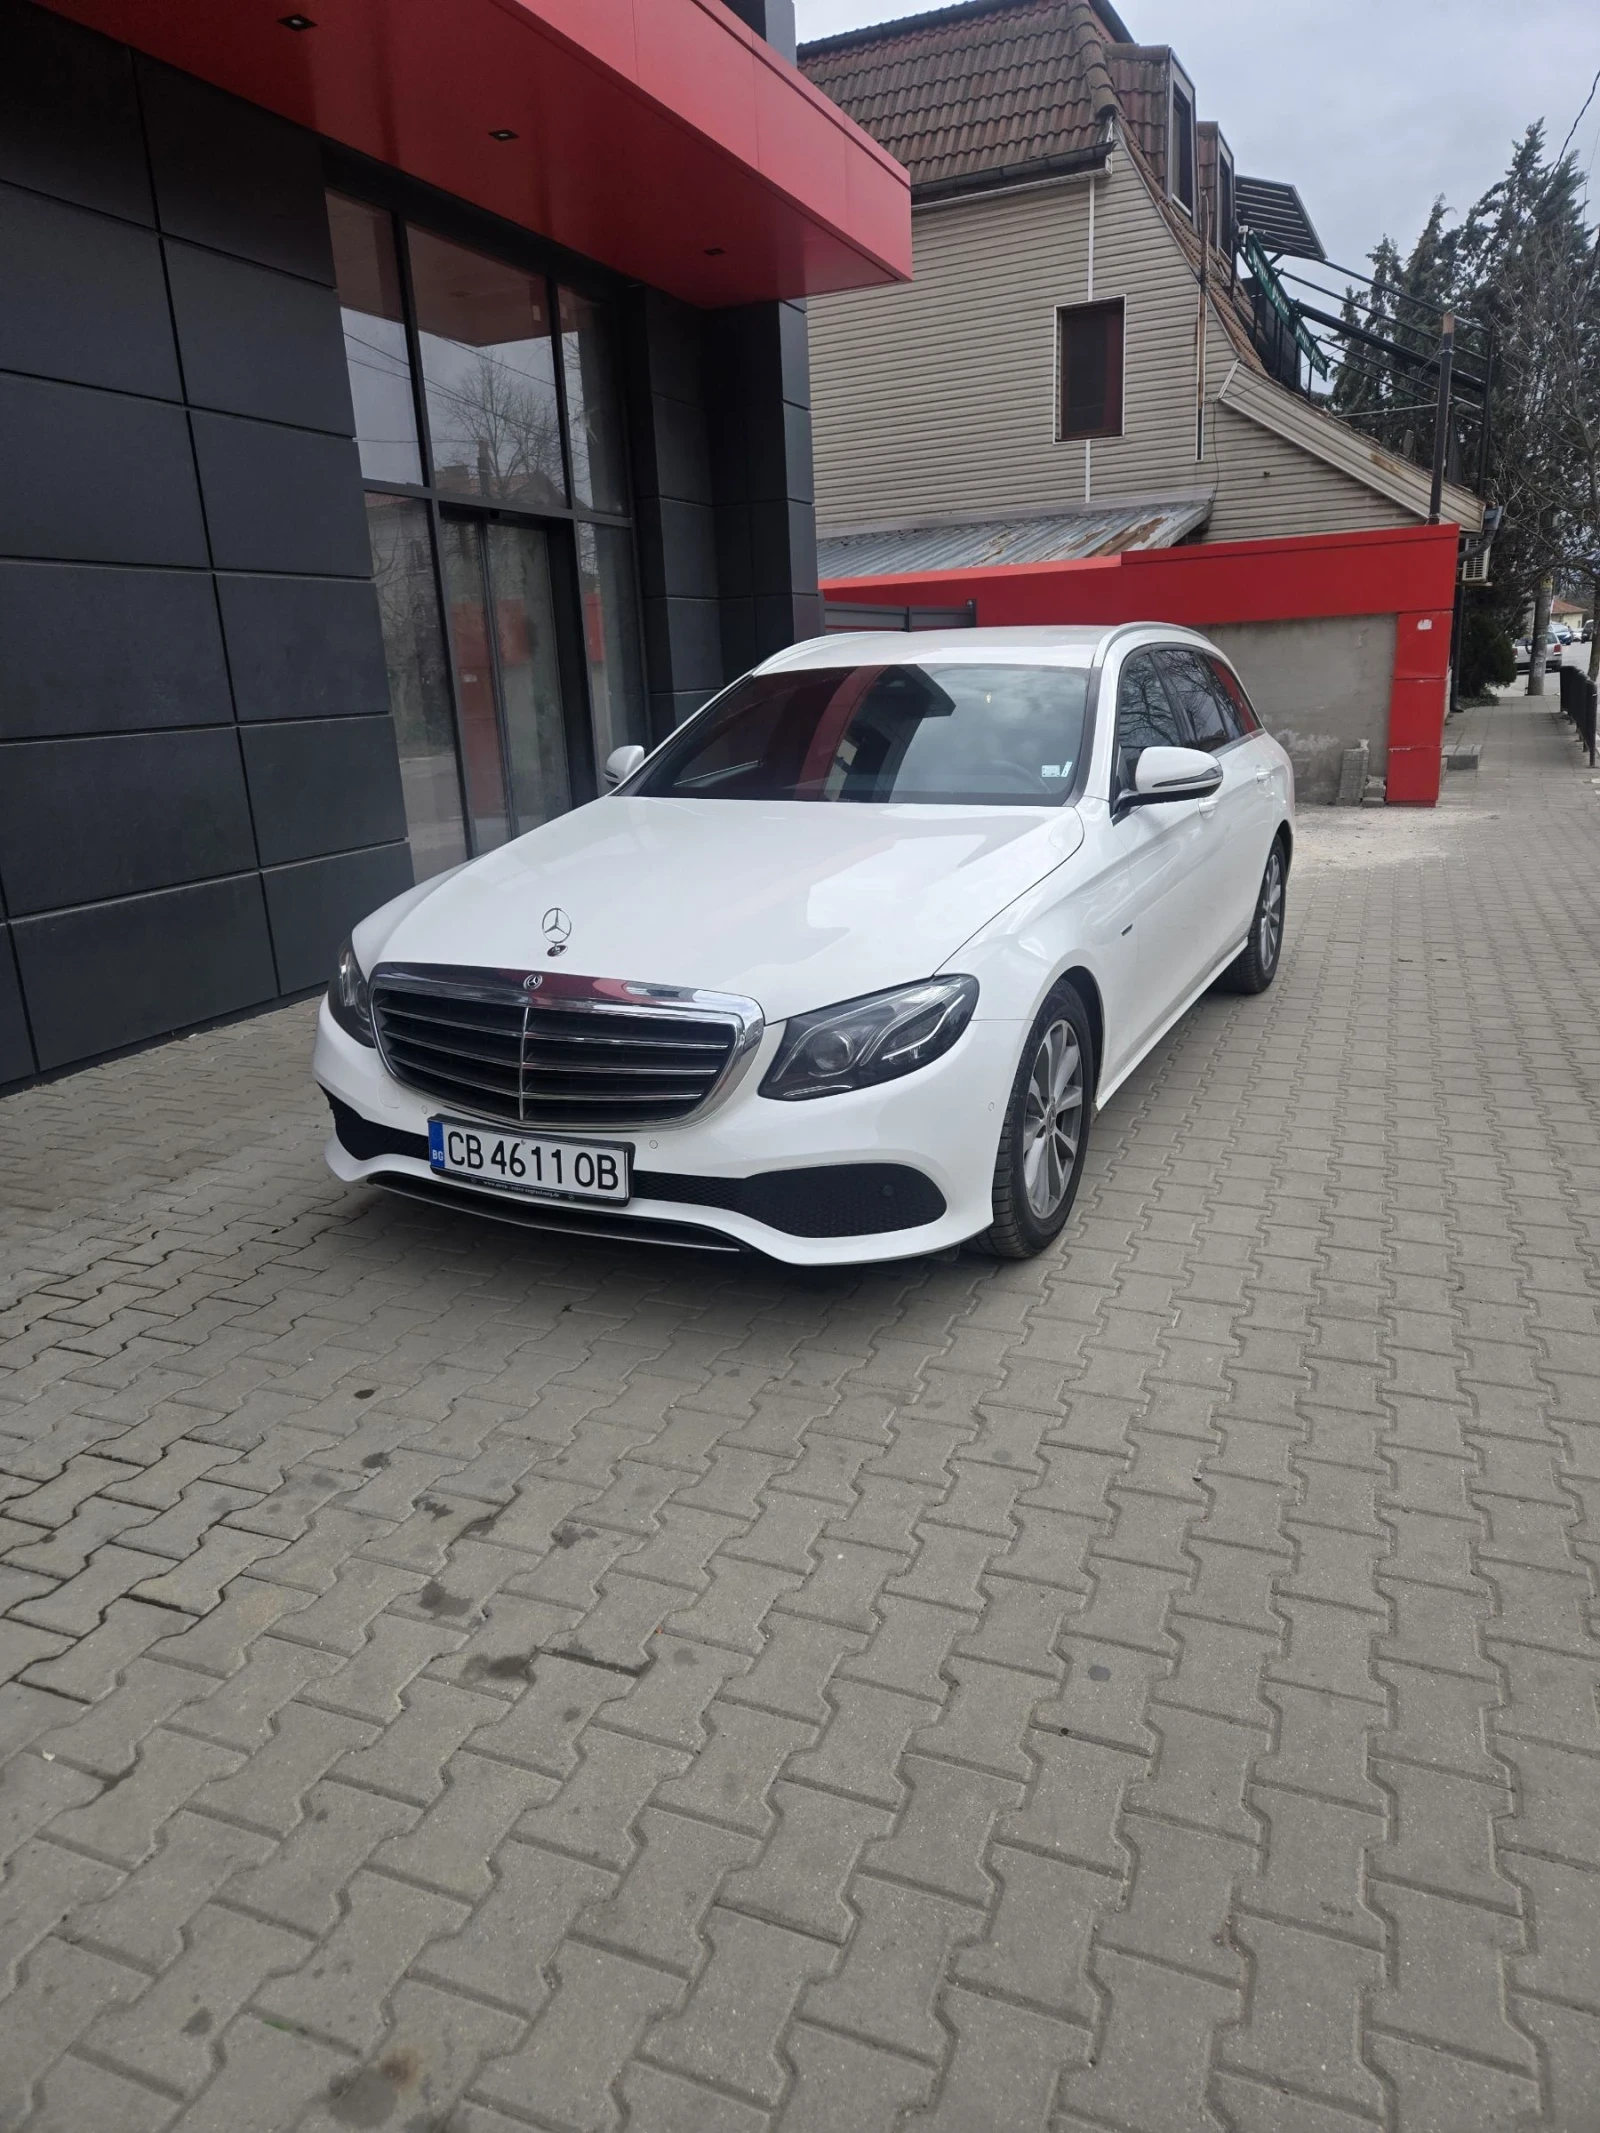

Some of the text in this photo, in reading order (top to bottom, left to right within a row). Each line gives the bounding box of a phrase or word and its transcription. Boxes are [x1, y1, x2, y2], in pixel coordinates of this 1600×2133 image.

[432, 1149, 444, 1161] BG
[448, 1131, 484, 1169] CB
[491, 1140, 563, 1184] 4611
[574, 1152, 619, 1190] OB
